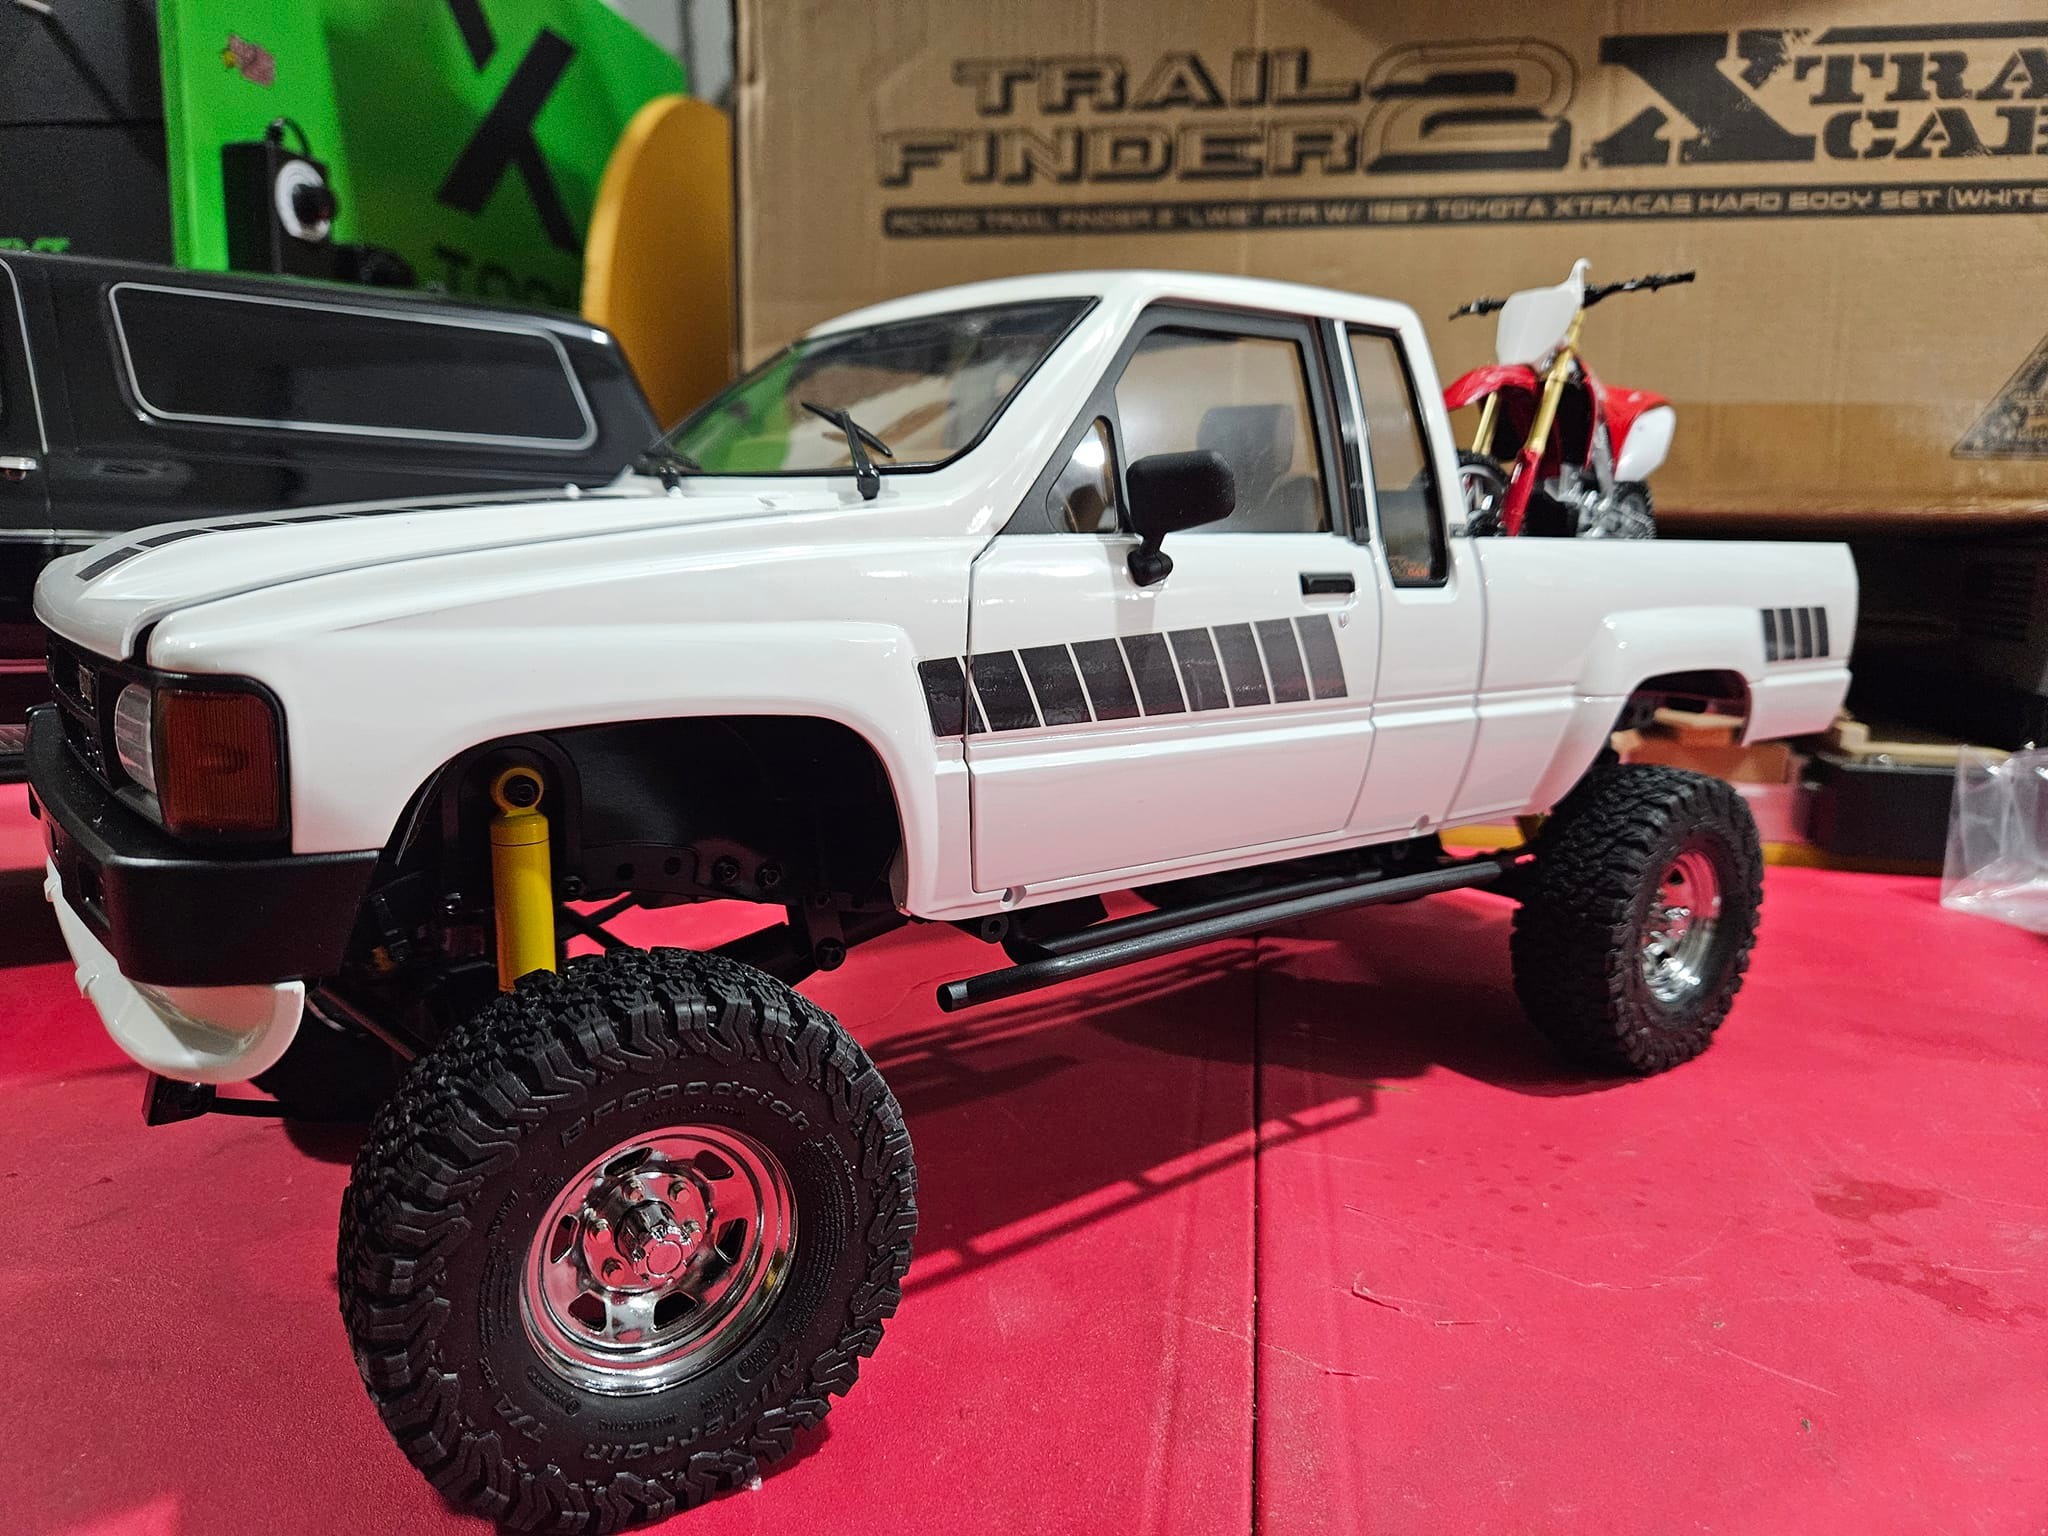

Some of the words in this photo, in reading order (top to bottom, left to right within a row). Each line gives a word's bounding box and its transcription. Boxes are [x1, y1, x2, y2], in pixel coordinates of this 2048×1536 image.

[951, 48, 1361, 116] TRAIL
[1362, 40, 1578, 174] 2
[879, 117, 1359, 188] FINDER
[1433, 197, 1545, 220] TOYOTA
[1553, 194, 1692, 218] XTRACAB
[1698, 191, 1782, 212] HARD
[1788, 189, 1873, 210] BODY
[1879, 188, 1943, 208] SET
[1948, 186, 2048, 210] (WHITE
